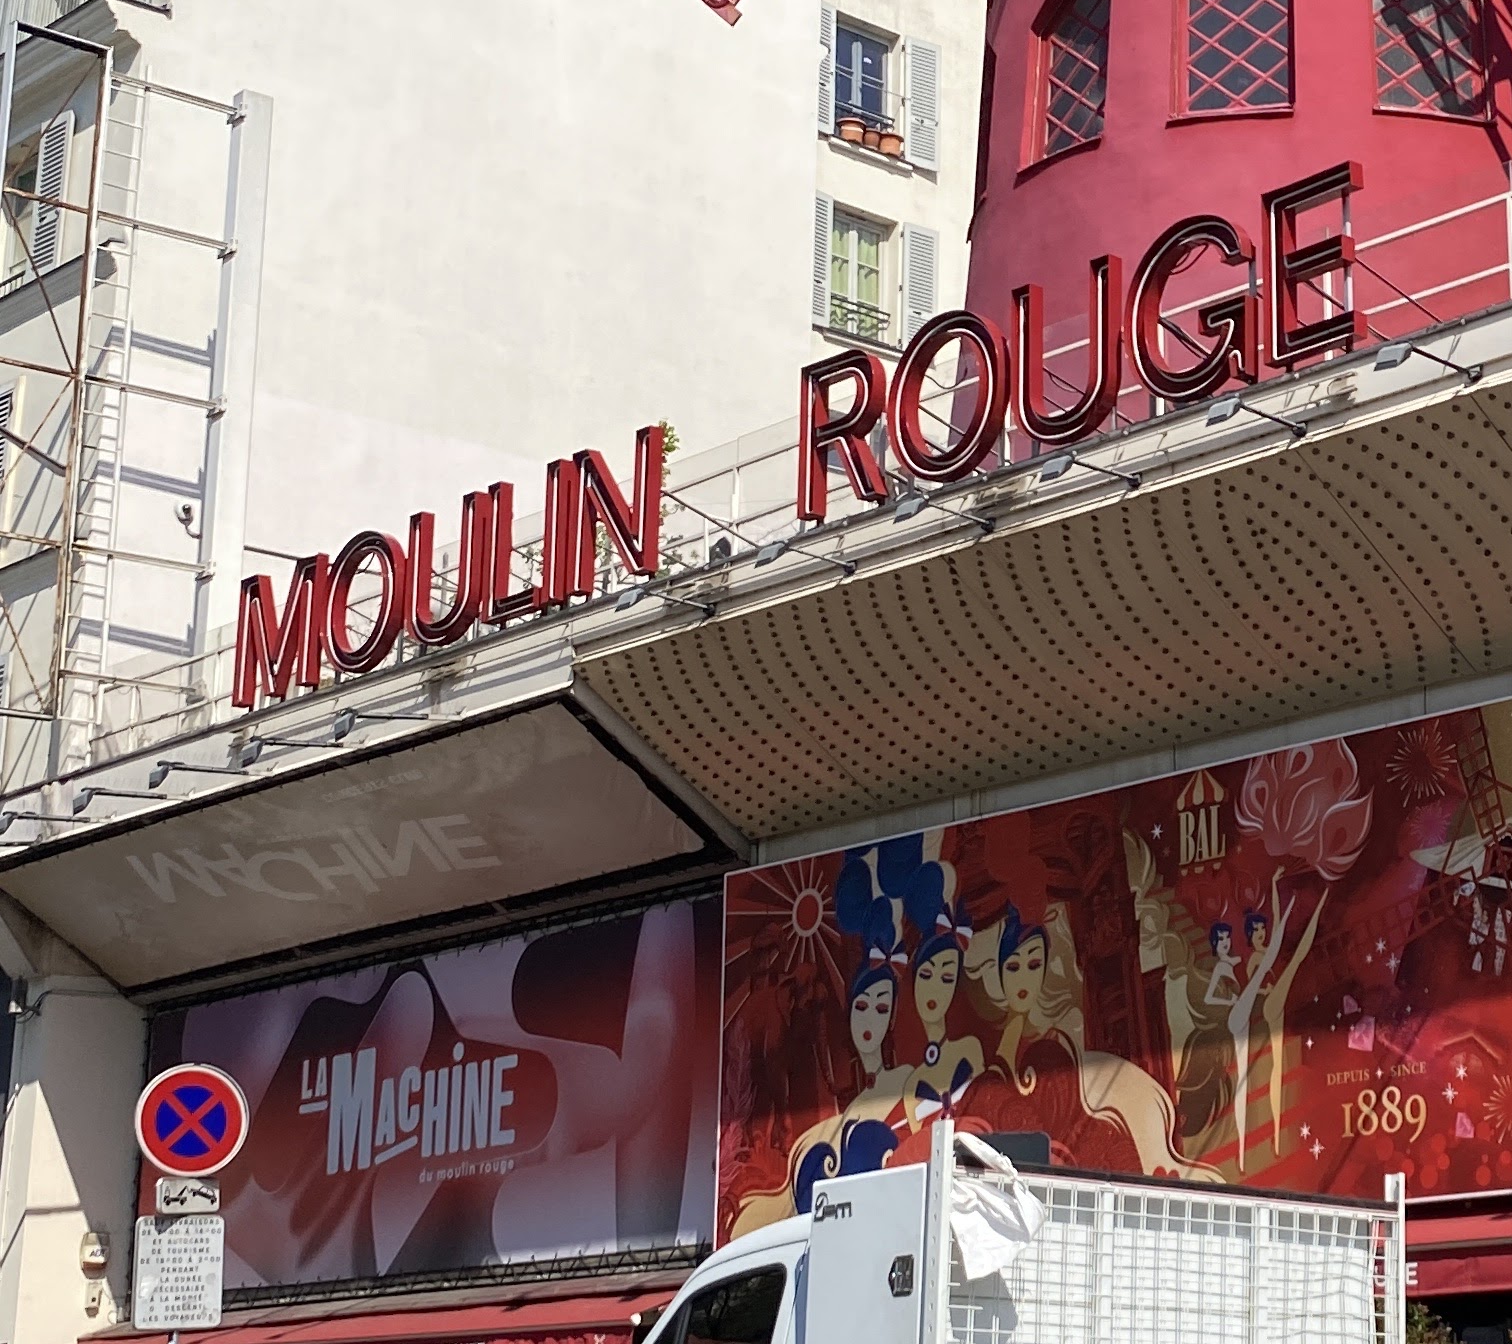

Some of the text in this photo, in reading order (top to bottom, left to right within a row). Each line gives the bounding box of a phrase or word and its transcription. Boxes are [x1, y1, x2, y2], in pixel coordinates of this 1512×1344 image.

[232, 160, 1368, 708] MOULIN ROUGE
[1178, 805, 1226, 865] BAL
[302, 1057, 328, 1099] LA
[1326, 1061, 1427, 1086] DEPUIS SINCE
[1341, 1086, 1427, 1144] 1889
[436, 1162, 476, 1182] moulin
[479, 1158, 514, 1176] rouge
